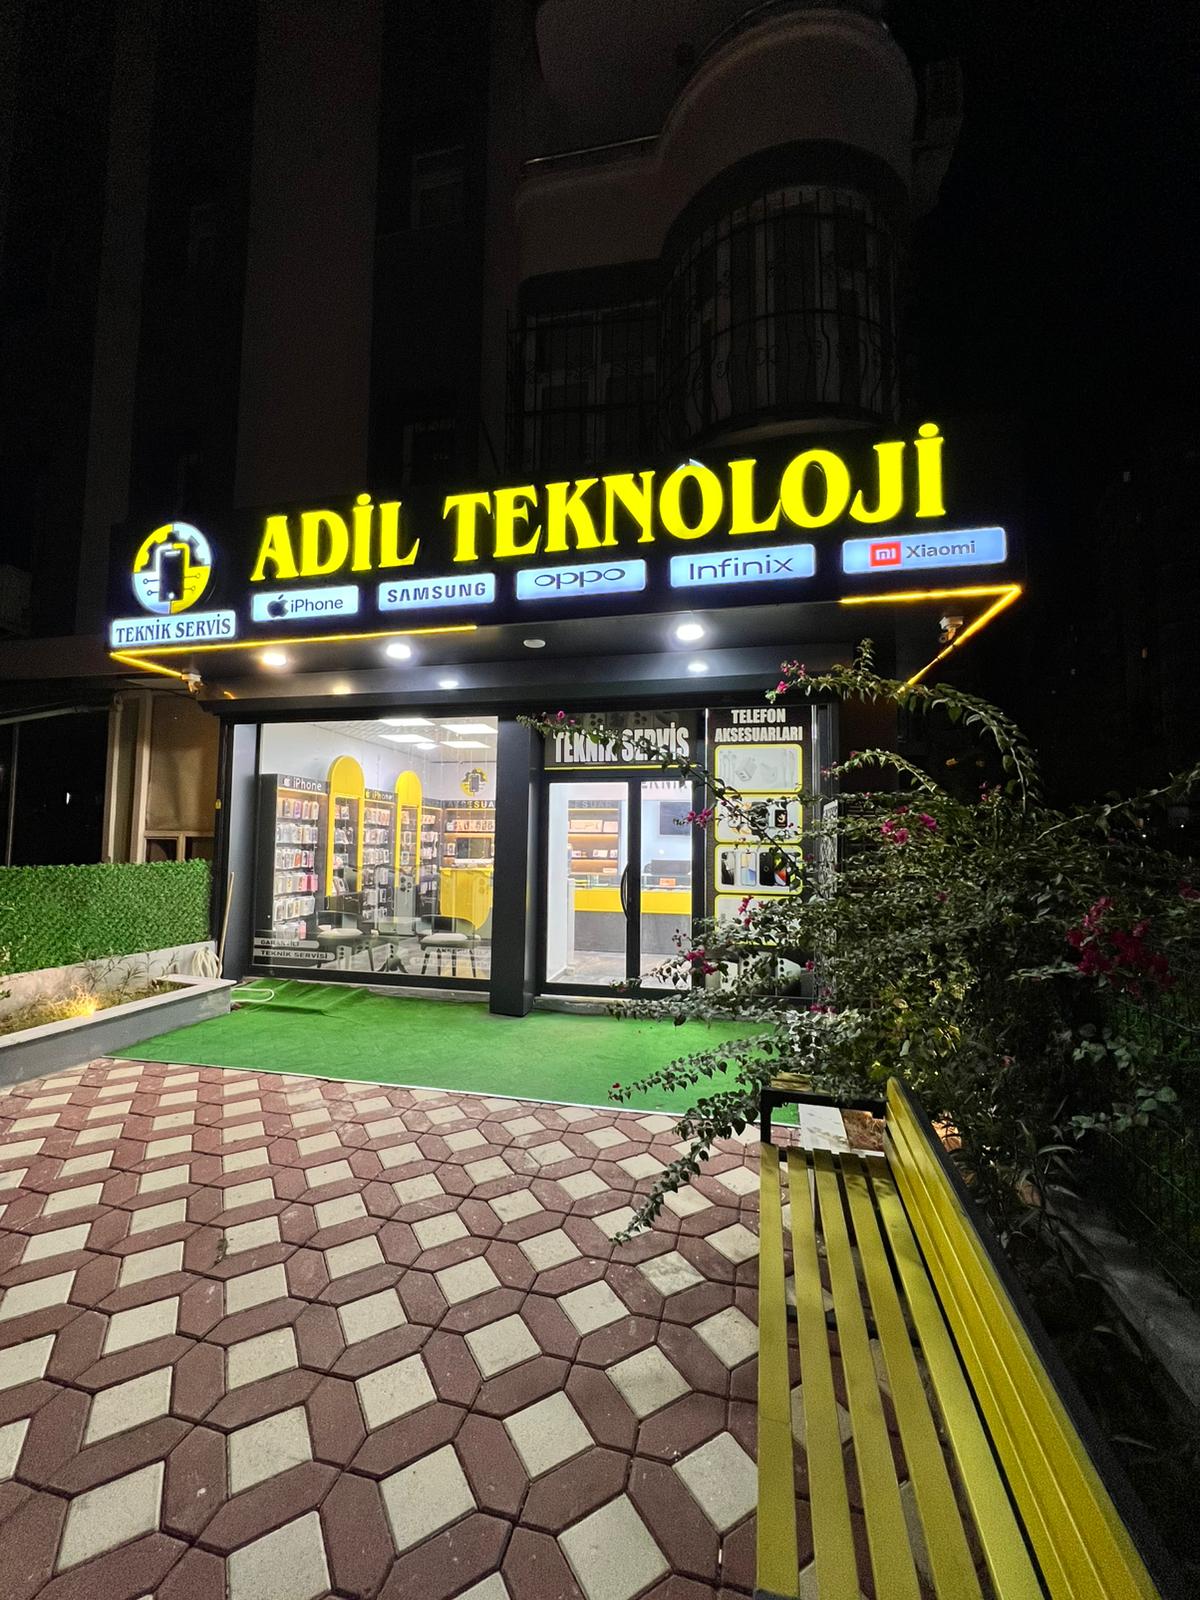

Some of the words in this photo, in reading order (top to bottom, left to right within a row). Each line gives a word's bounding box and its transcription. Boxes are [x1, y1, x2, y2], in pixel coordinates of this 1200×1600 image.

[250, 493, 420, 582] ADİL
[442, 423, 946, 563] TEKNOLOJİ
[906, 540, 975, 559] Xiaomi
[689, 554, 793, 580] Infinix
[387, 581, 486, 603] SAMSUNG
[290, 598, 344, 613] iPhone
[116, 618, 171, 643] TEKNİK
[175, 613, 231, 638] SERVİS
[731, 708, 786, 724] TELEFON
[714, 726, 803, 742] AKSESUARLARI
[293, 777, 322, 791] iPhone
[372, 792, 393, 801] iPhone
